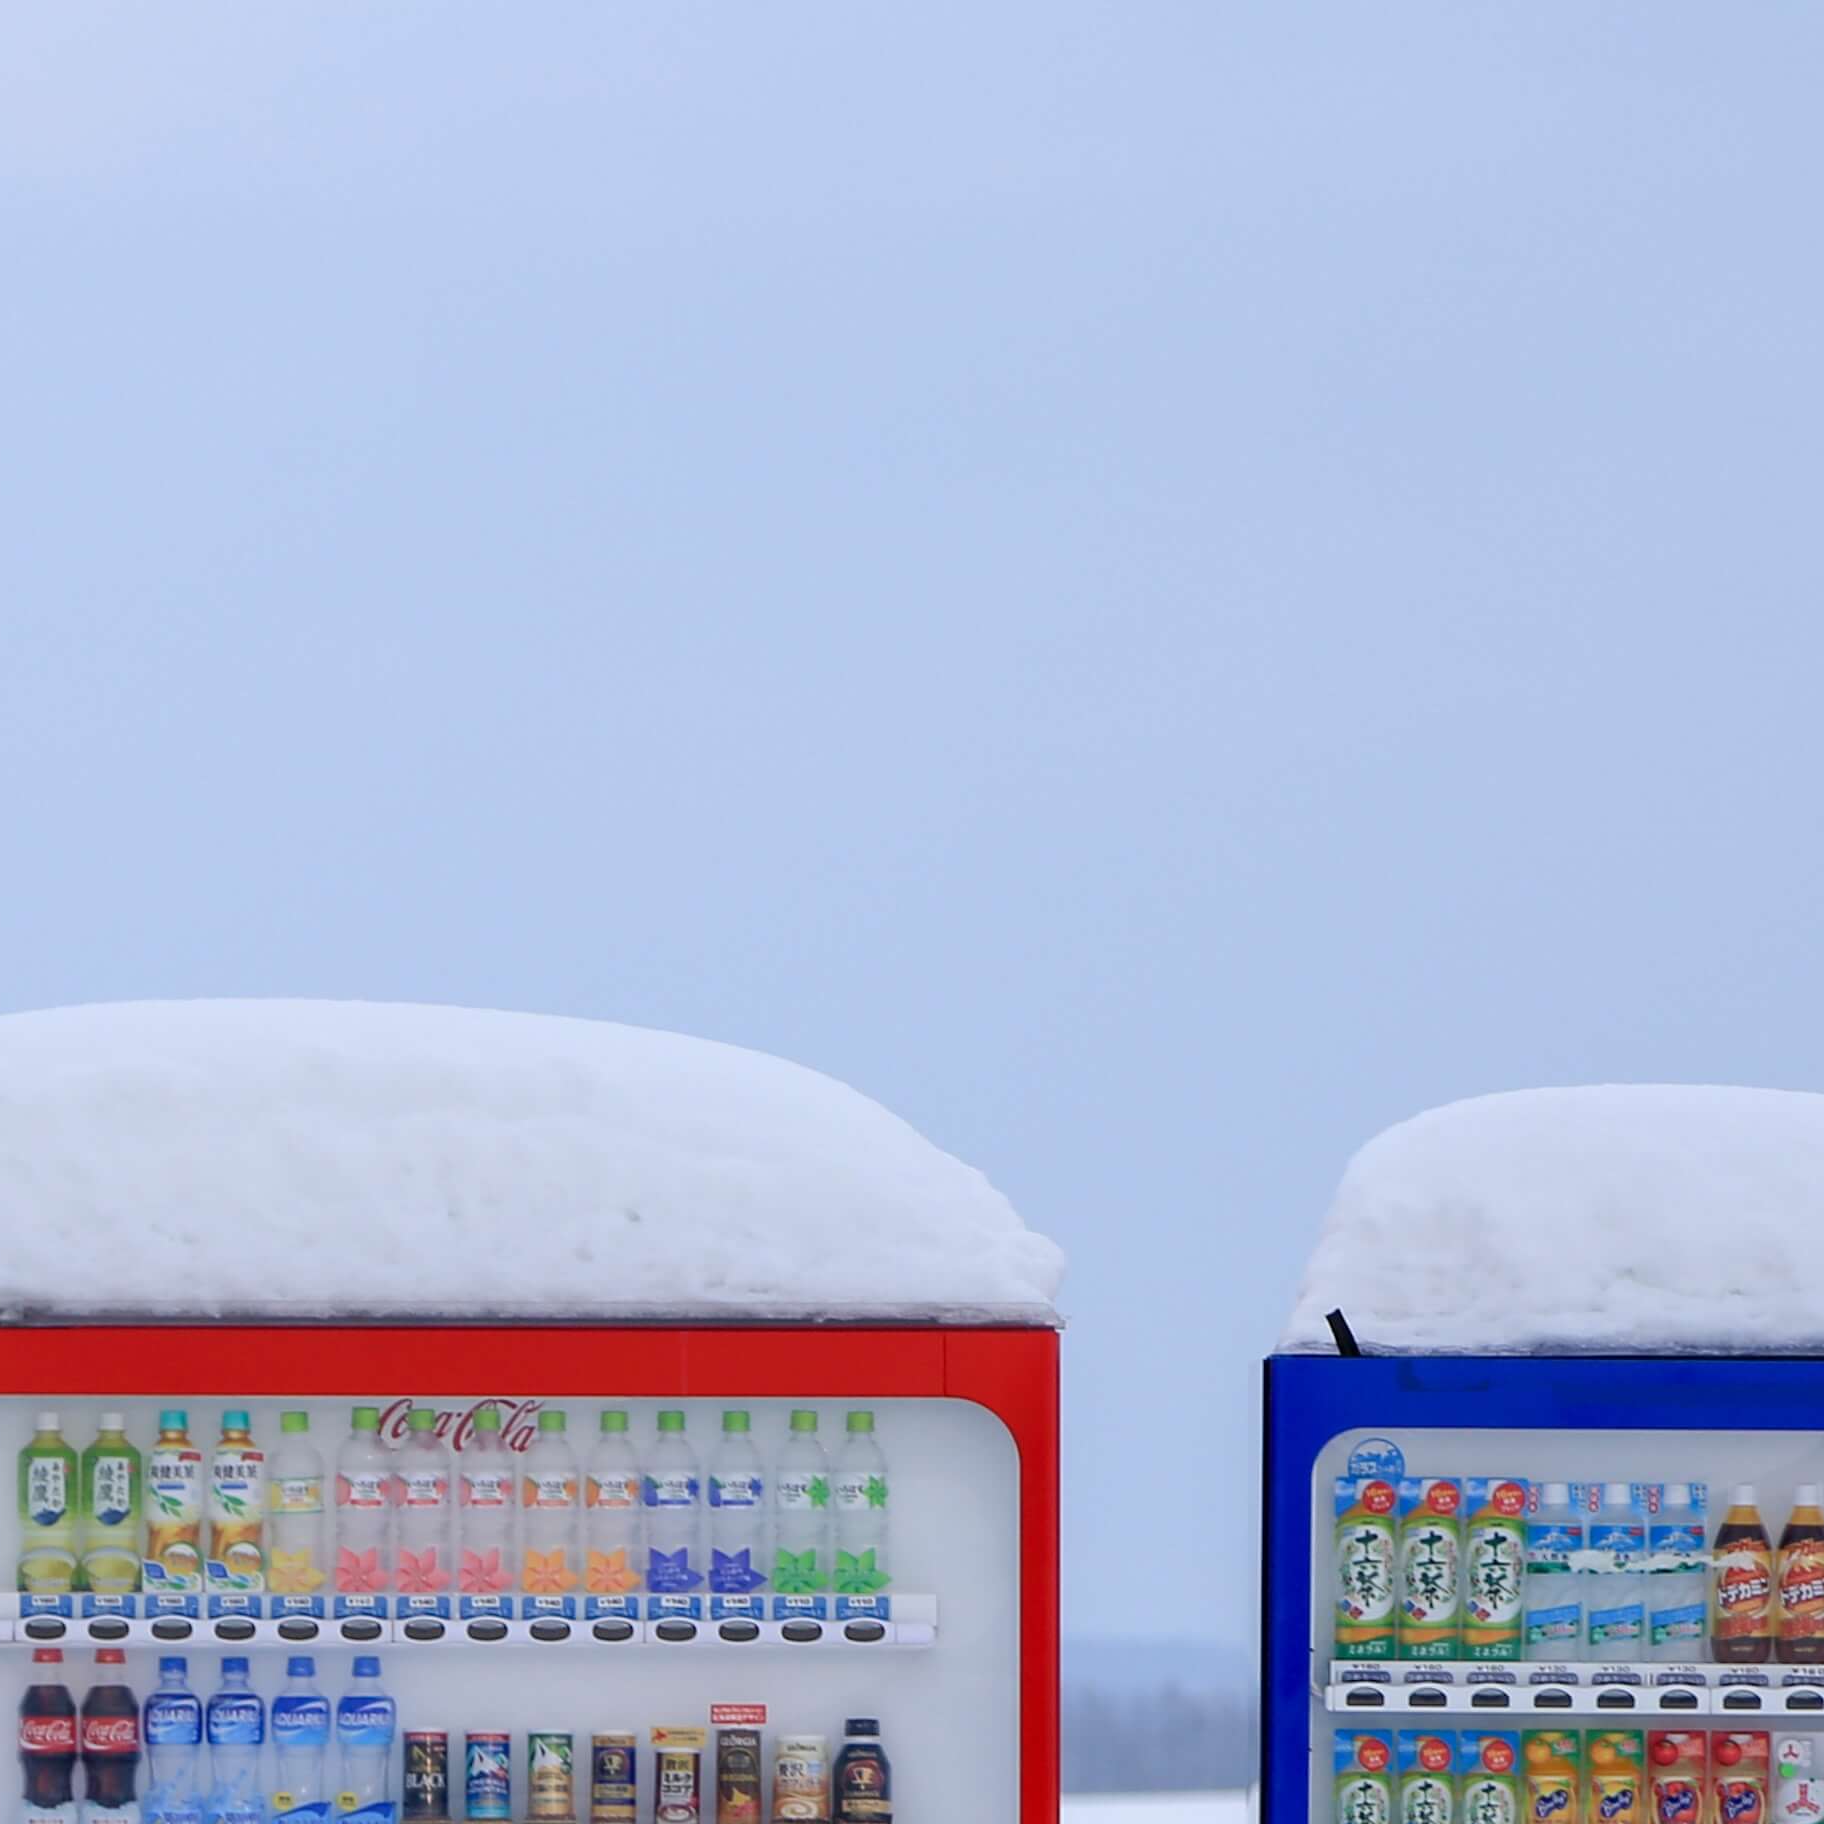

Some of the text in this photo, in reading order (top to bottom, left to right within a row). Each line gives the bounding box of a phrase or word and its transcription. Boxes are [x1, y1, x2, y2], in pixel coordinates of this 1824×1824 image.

[378, 1399, 545, 1452] Coa-Cla
[1352, 1530, 1384, 1607] 十六茶
[1416, 1530, 1449, 1609] 十六茶
[1480, 1531, 1513, 1610] 十六茶
[23, 1720, 72, 1742] Coca-Cola
[86, 1720, 136, 1742] Coca-Cola
[405, 1772, 445, 1788] BLACK
